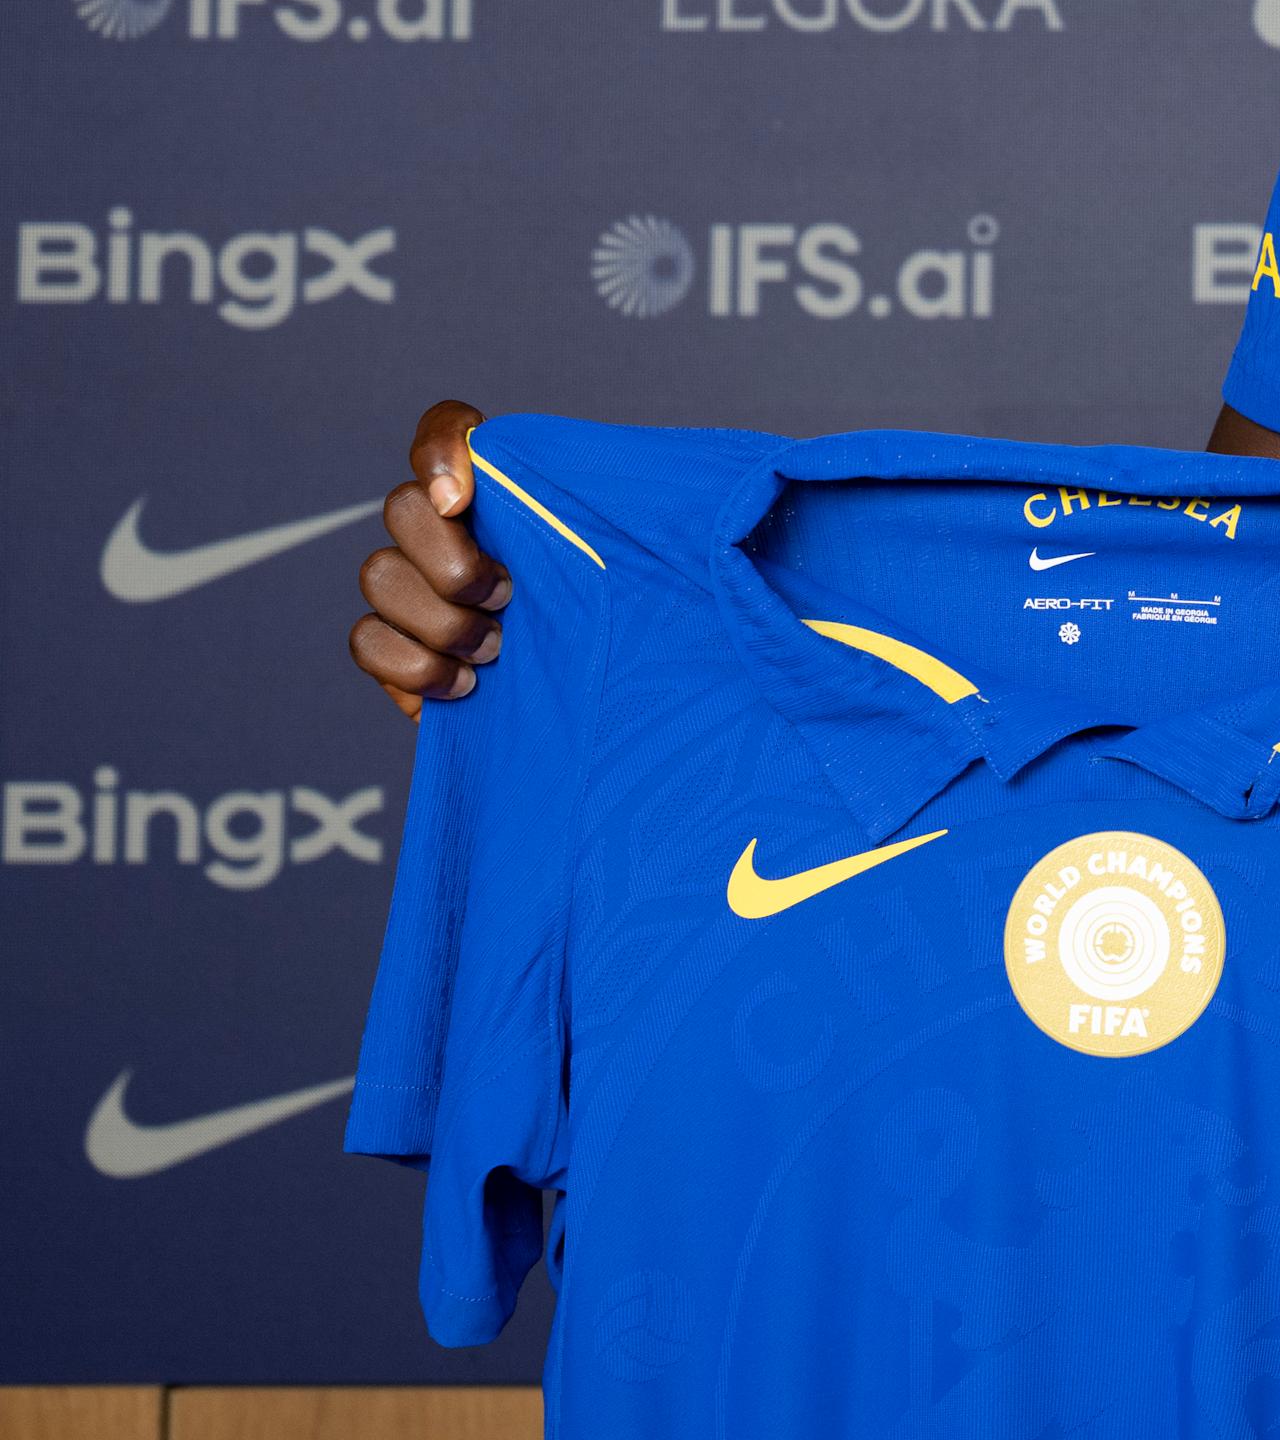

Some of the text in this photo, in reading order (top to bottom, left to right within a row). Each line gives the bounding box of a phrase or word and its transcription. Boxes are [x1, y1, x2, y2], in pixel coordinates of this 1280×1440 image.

[17, 207, 397, 330] Bingx
[709, 214, 998, 320] IFS.ai
[1023, 598, 1115, 610] AERO-FIT
[1127, 590, 1136, 598] M
[1170, 592, 1178, 600] M
[1141, 606, 1209, 617] MADE IN GEORGIA
[1171, 614, 1183, 622] EN
[2, 766, 385, 891] Bingx
[1023, 850, 1207, 975] WORLD CHAMPIONS
